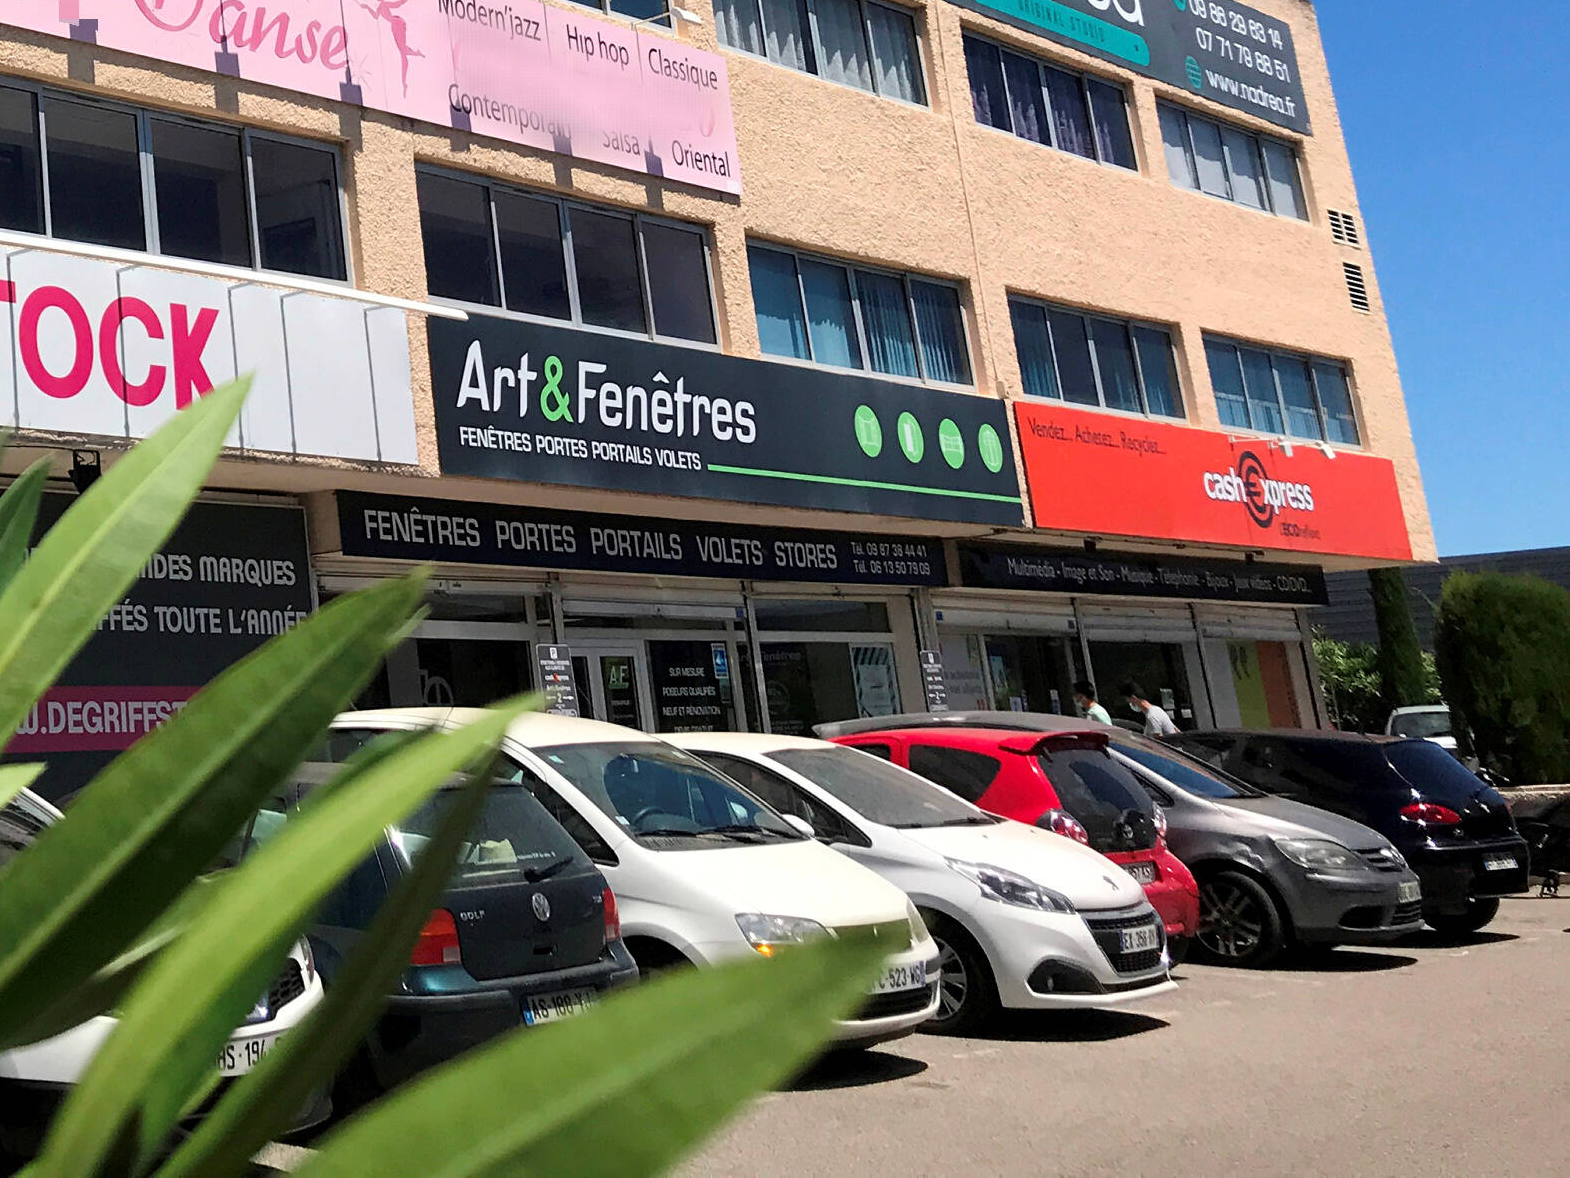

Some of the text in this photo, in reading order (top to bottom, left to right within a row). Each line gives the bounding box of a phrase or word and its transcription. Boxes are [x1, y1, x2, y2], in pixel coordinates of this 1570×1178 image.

[648, 48, 719, 93] Classique
[1196, 27, 1213, 52] 07
[1216, 35, 1234, 61] 71
[1274, 59, 1291, 84] 51
[671, 139, 731, 178] Oriental
[459, 425, 702, 471] FENÊTRES PORTES PORTAILS VOLETS
[363, 506, 838, 570] FENÊTRES PORTES PORTAILS VOLETS STORES
[198, 555, 297, 588] MARQUES
[153, 605, 223, 634] TOUTE
